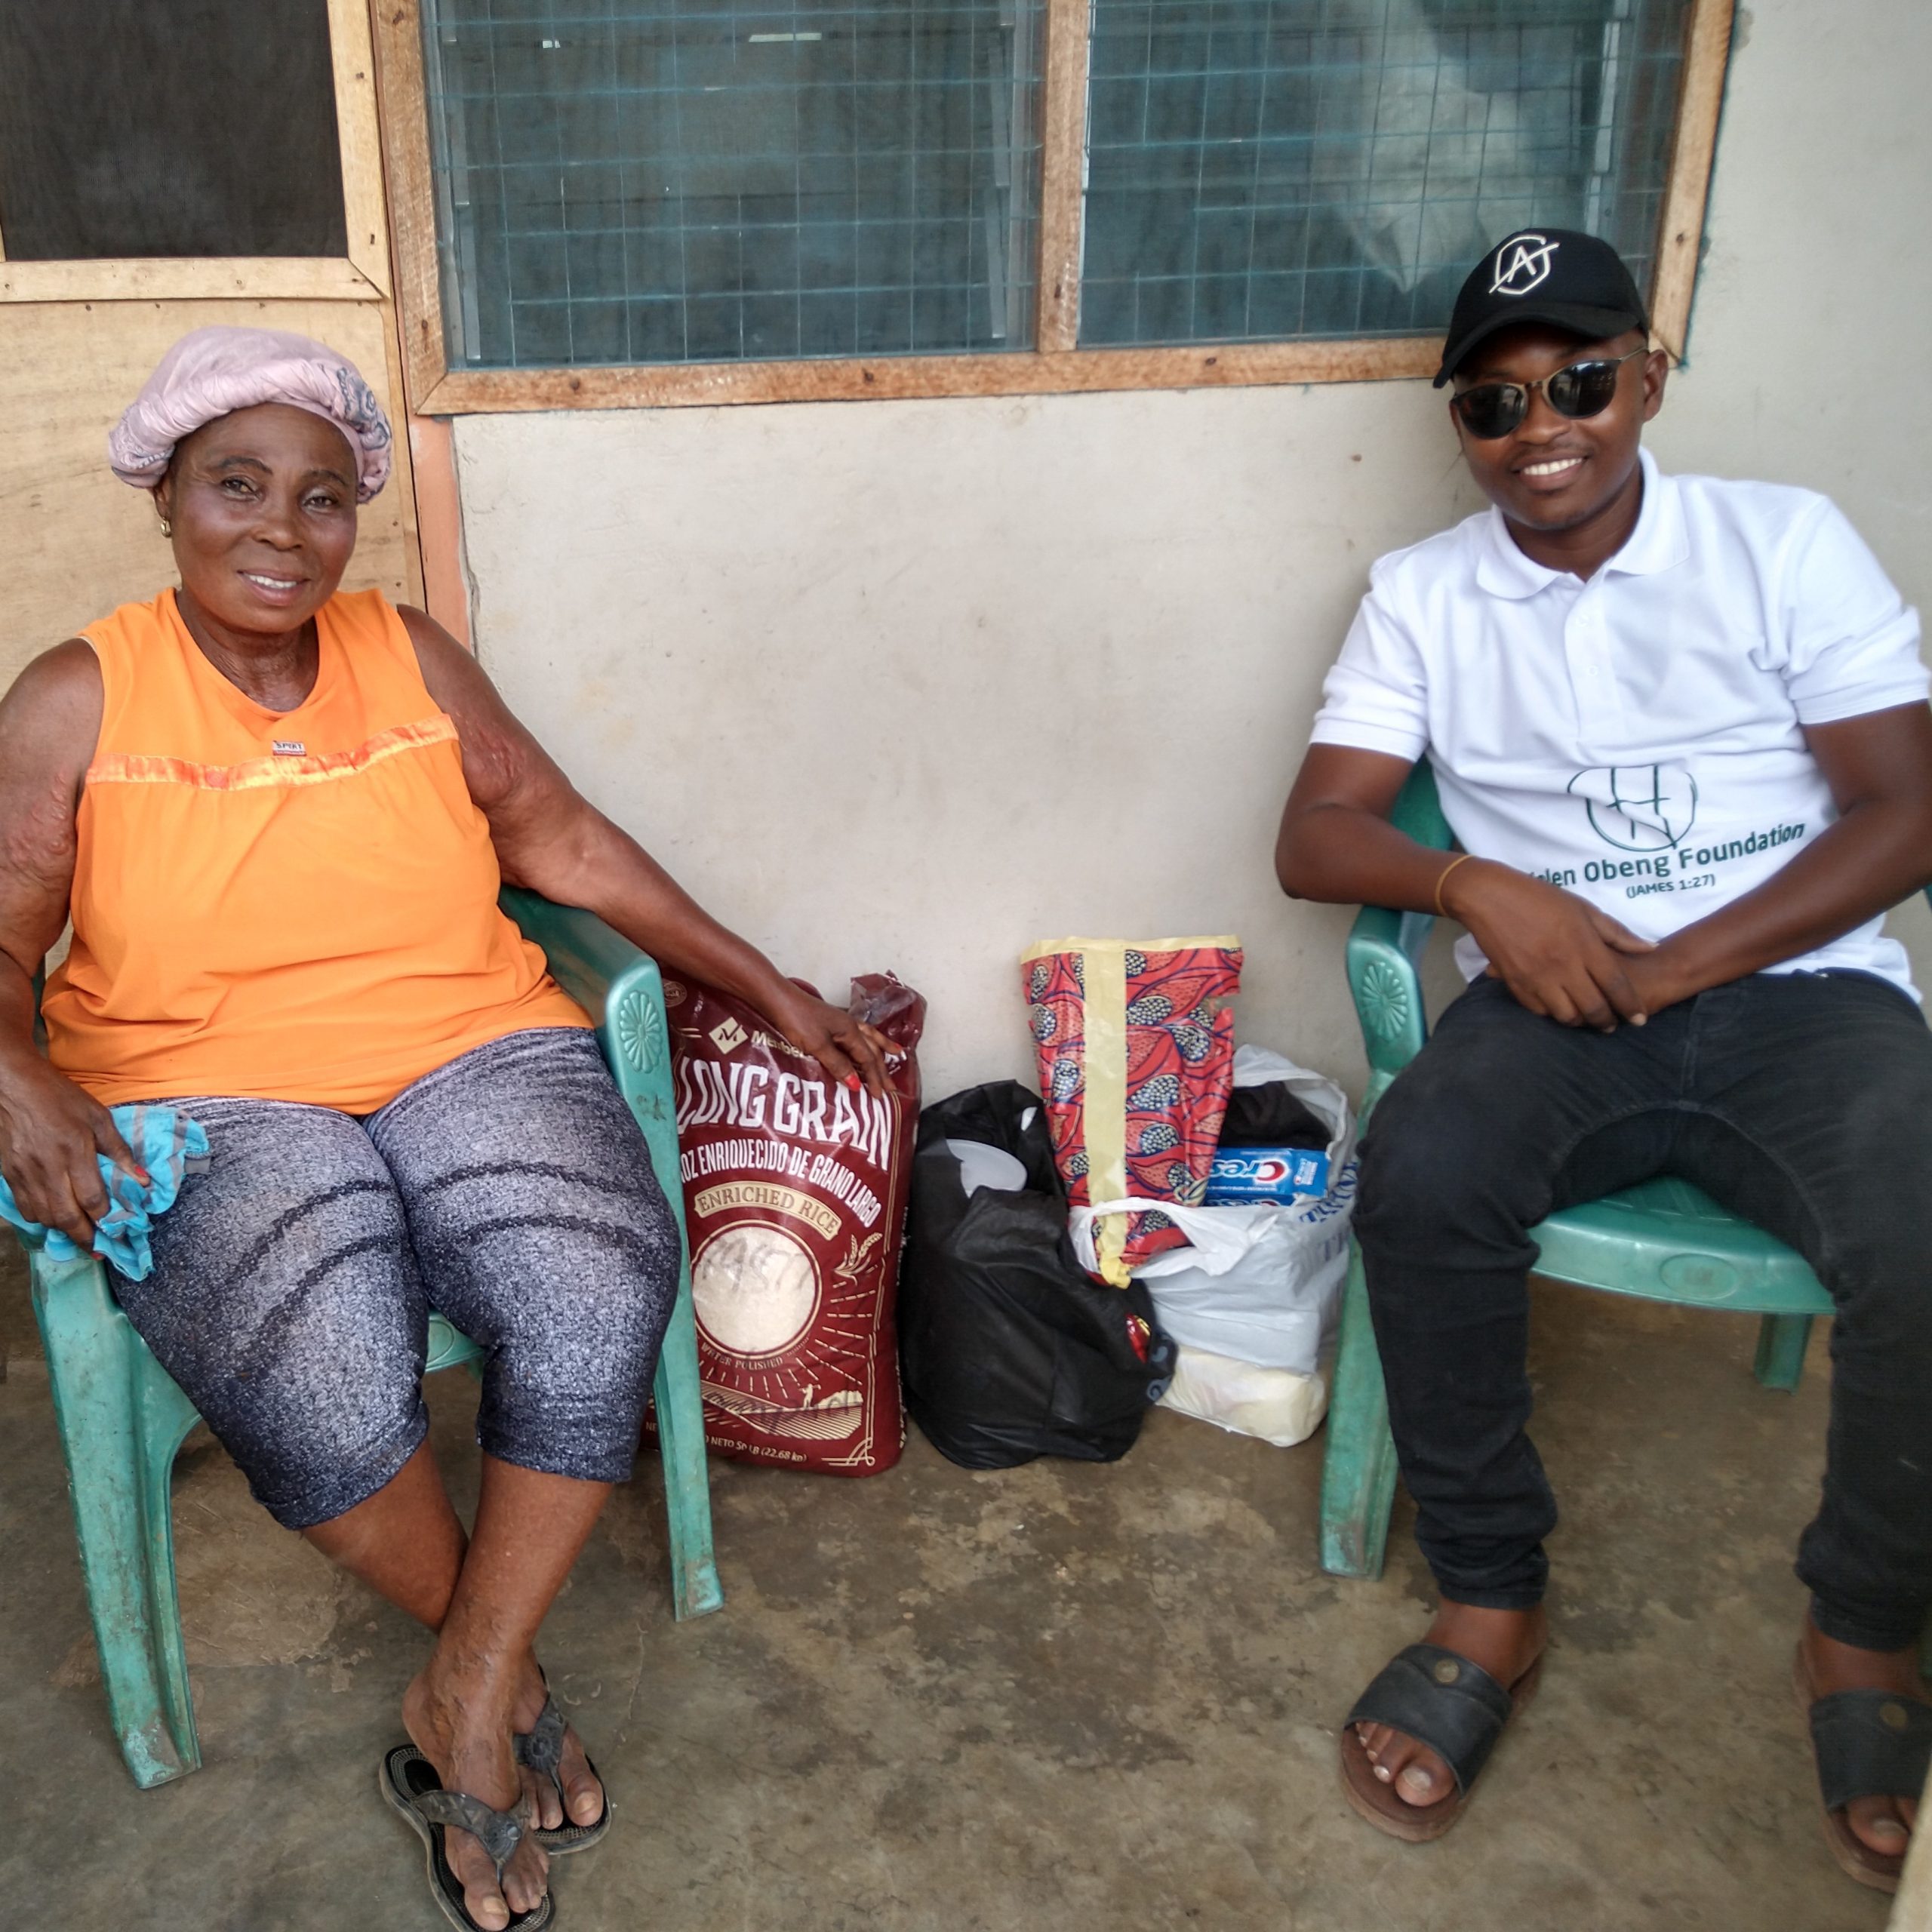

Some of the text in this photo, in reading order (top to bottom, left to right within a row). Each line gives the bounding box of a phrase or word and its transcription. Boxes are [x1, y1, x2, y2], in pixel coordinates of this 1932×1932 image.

[1530, 822, 1806, 887] len Obeng Foundation
[1626, 873, 1715, 899] (JAMES 1:27)
[677, 1057, 892, 1171] LONG GRAIN
[681, 1138, 881, 1228] OZ ENRIQUECIDO DE GRANO LARGO
[1209, 1158, 1287, 1183] Cres
[697, 1186, 838, 1234] ENRICHED RICE
[735, 1356, 783, 1371] POLISHED
[711, 1436, 735, 1447] NETO
